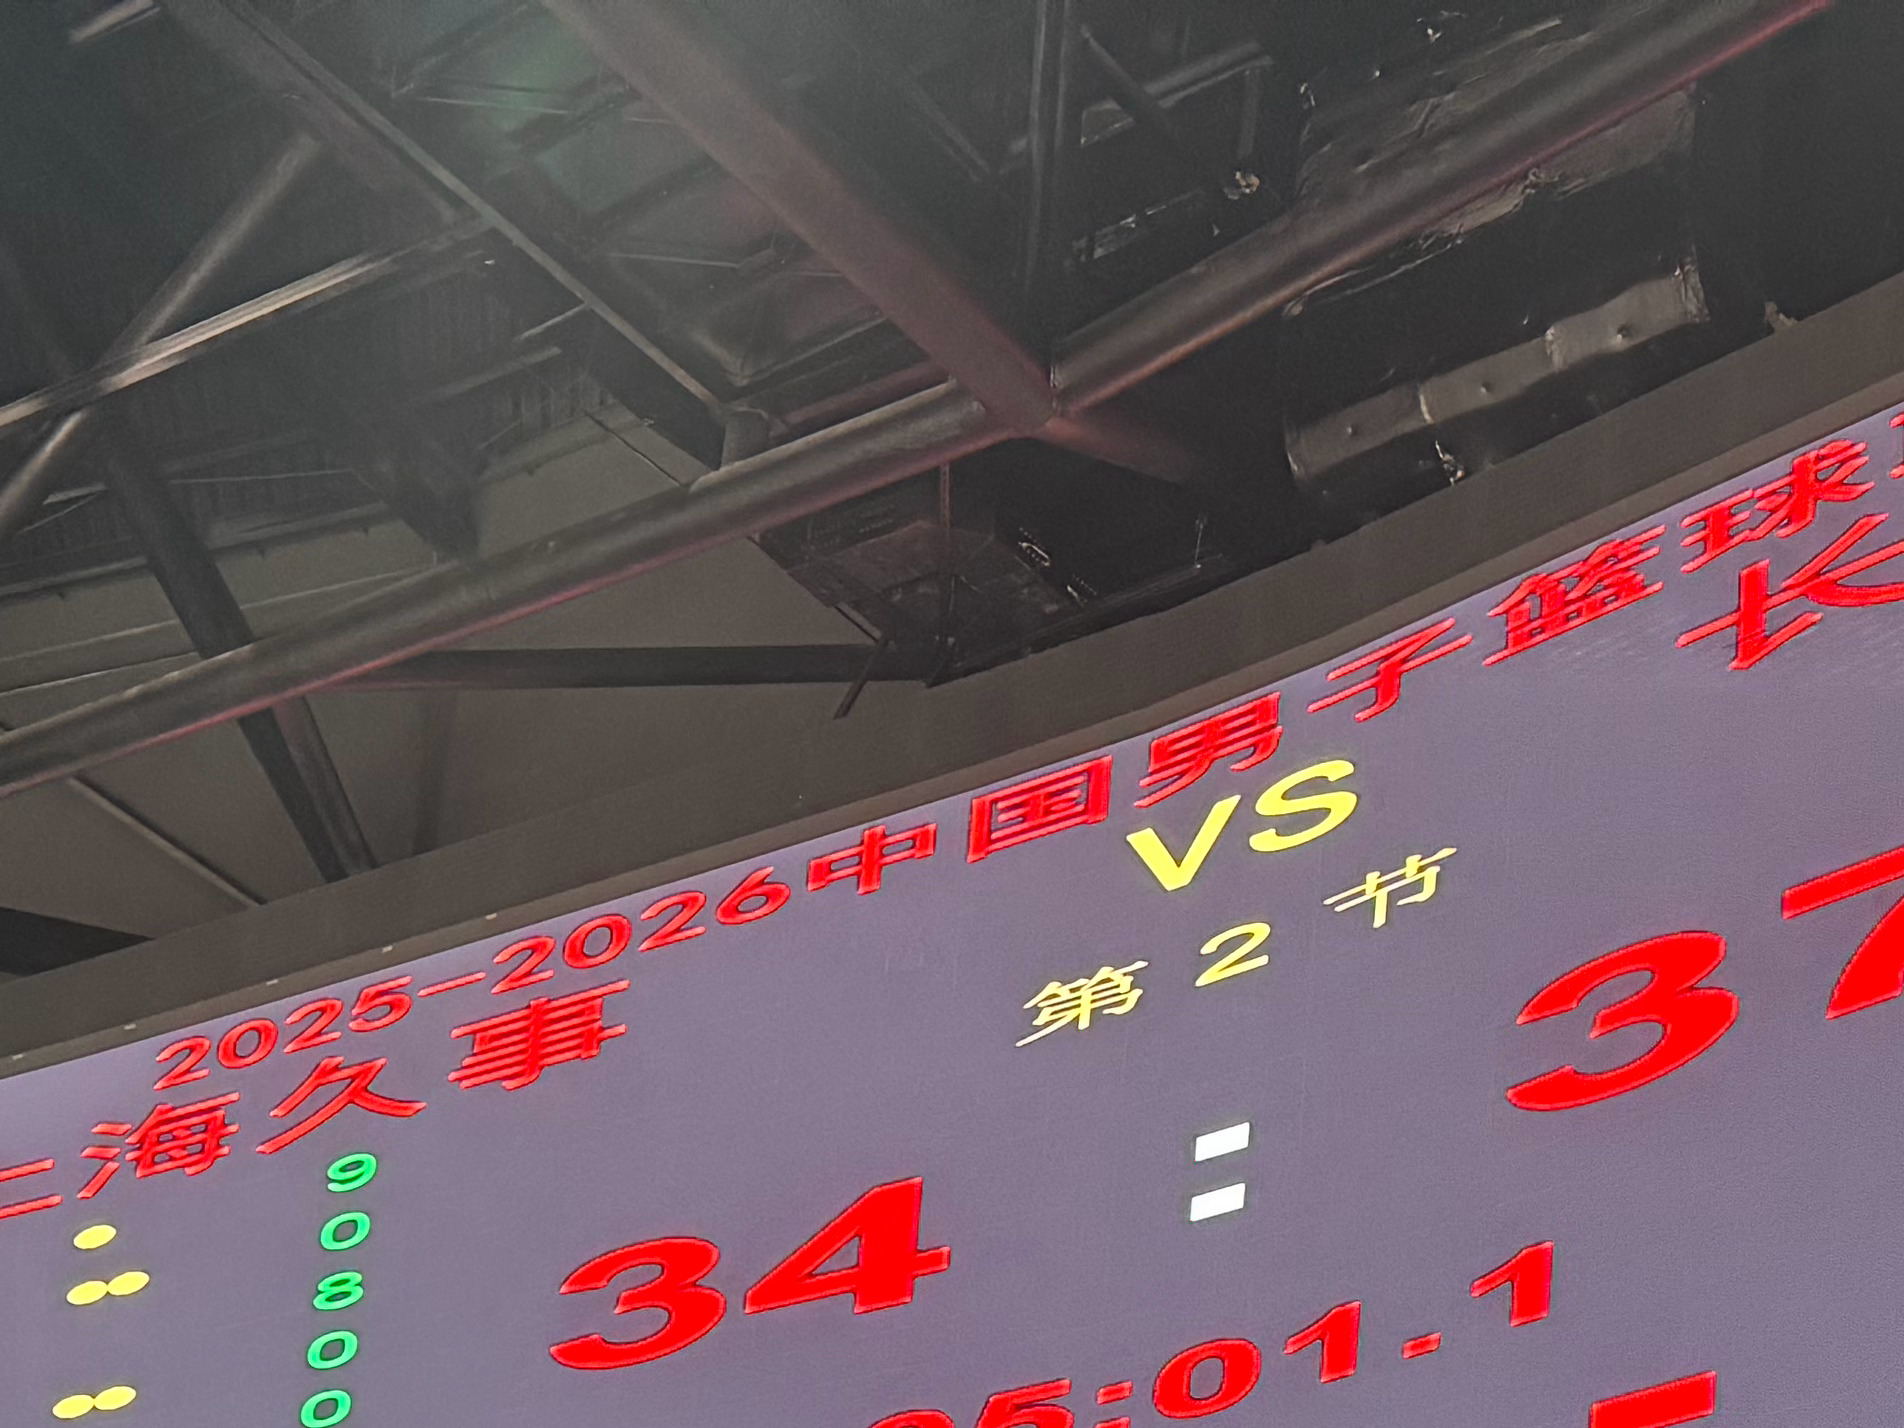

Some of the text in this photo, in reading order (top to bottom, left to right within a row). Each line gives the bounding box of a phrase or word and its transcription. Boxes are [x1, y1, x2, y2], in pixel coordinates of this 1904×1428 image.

[1128, 759, 1358, 892] VS
[328, 1154, 377, 1192] 9
[320, 1212, 370, 1250] 0
[313, 1272, 364, 1310] 8
[550, 1176, 952, 1370] 34
[307, 1331, 358, 1369] 0
[301, 1390, 351, 1428] 0
